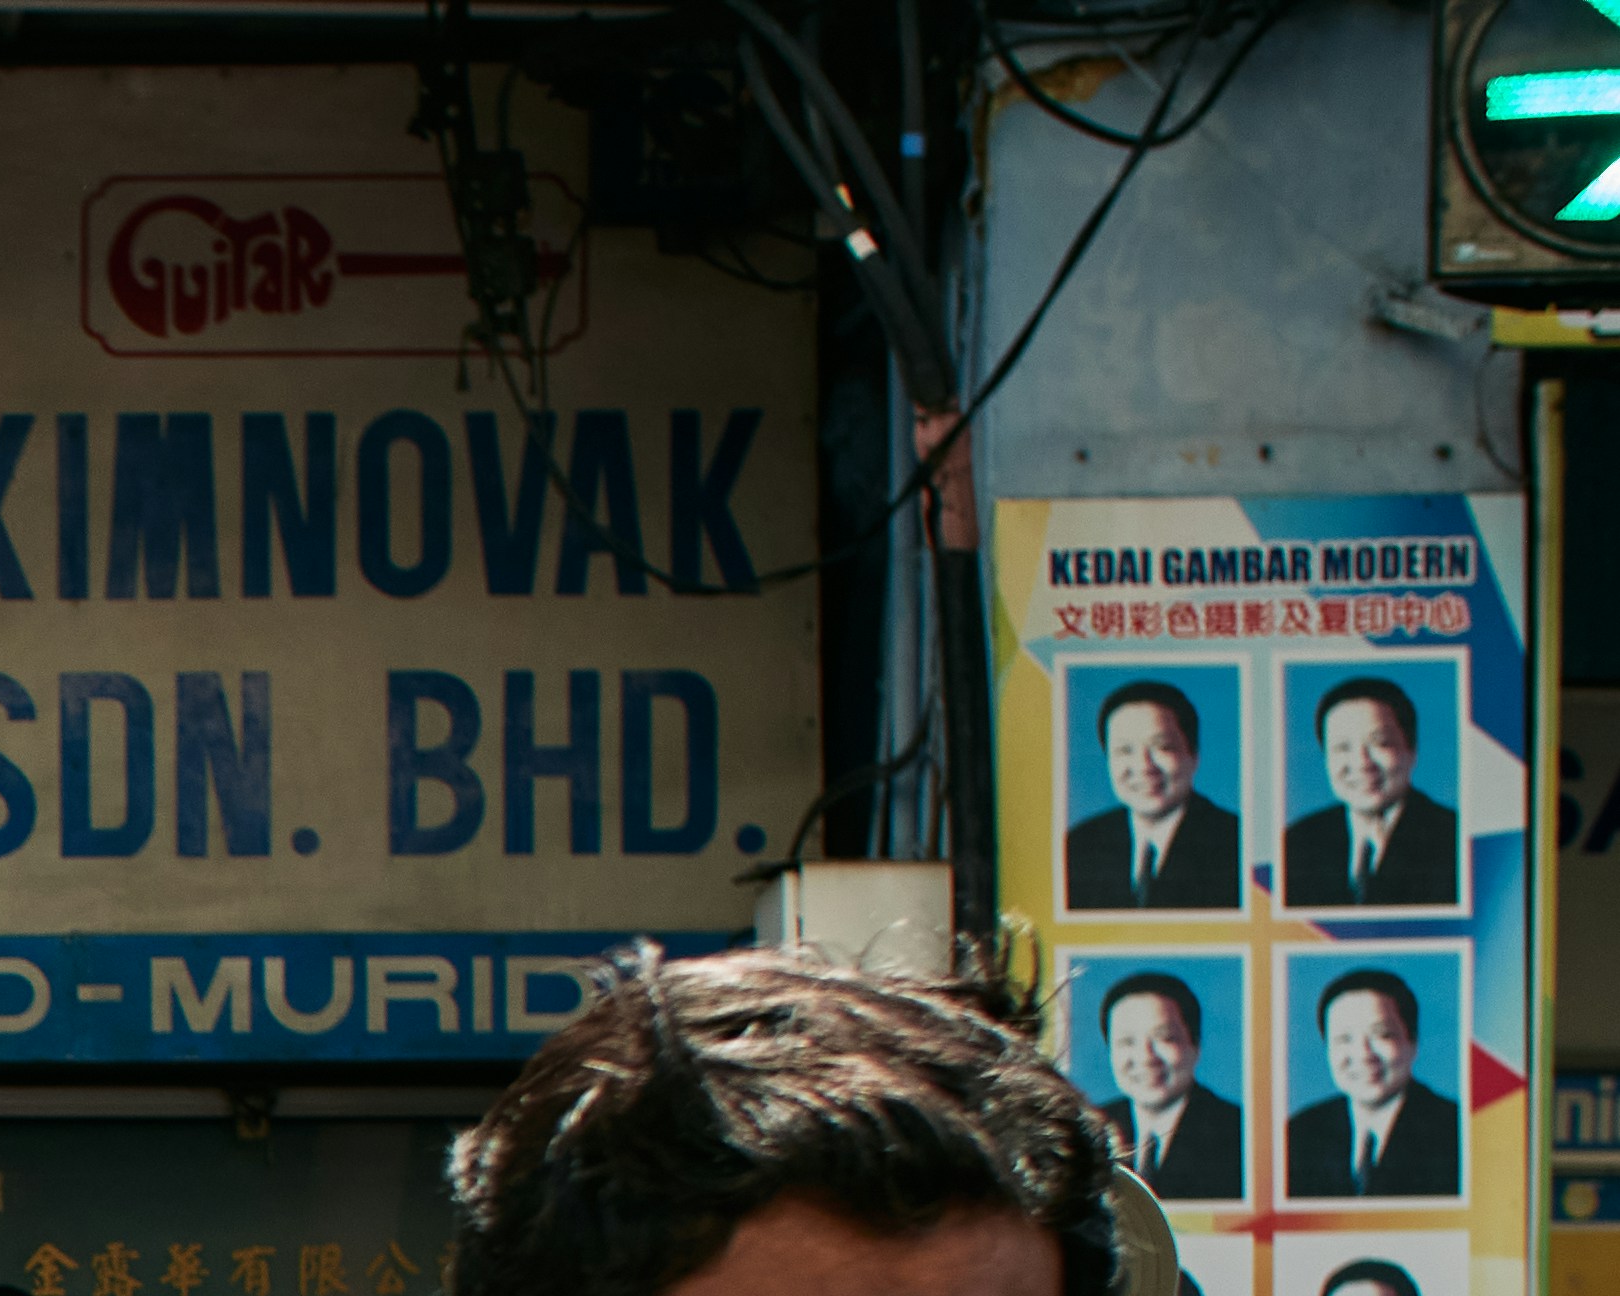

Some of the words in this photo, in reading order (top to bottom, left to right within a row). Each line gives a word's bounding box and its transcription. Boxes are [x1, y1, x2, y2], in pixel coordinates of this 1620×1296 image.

[1049, 546, 1154, 586] KEDAI
[1161, 544, 1312, 585] GAMBAR
[1320, 542, 1470, 582] MODERN
[387, 669, 768, 857] BHD.
